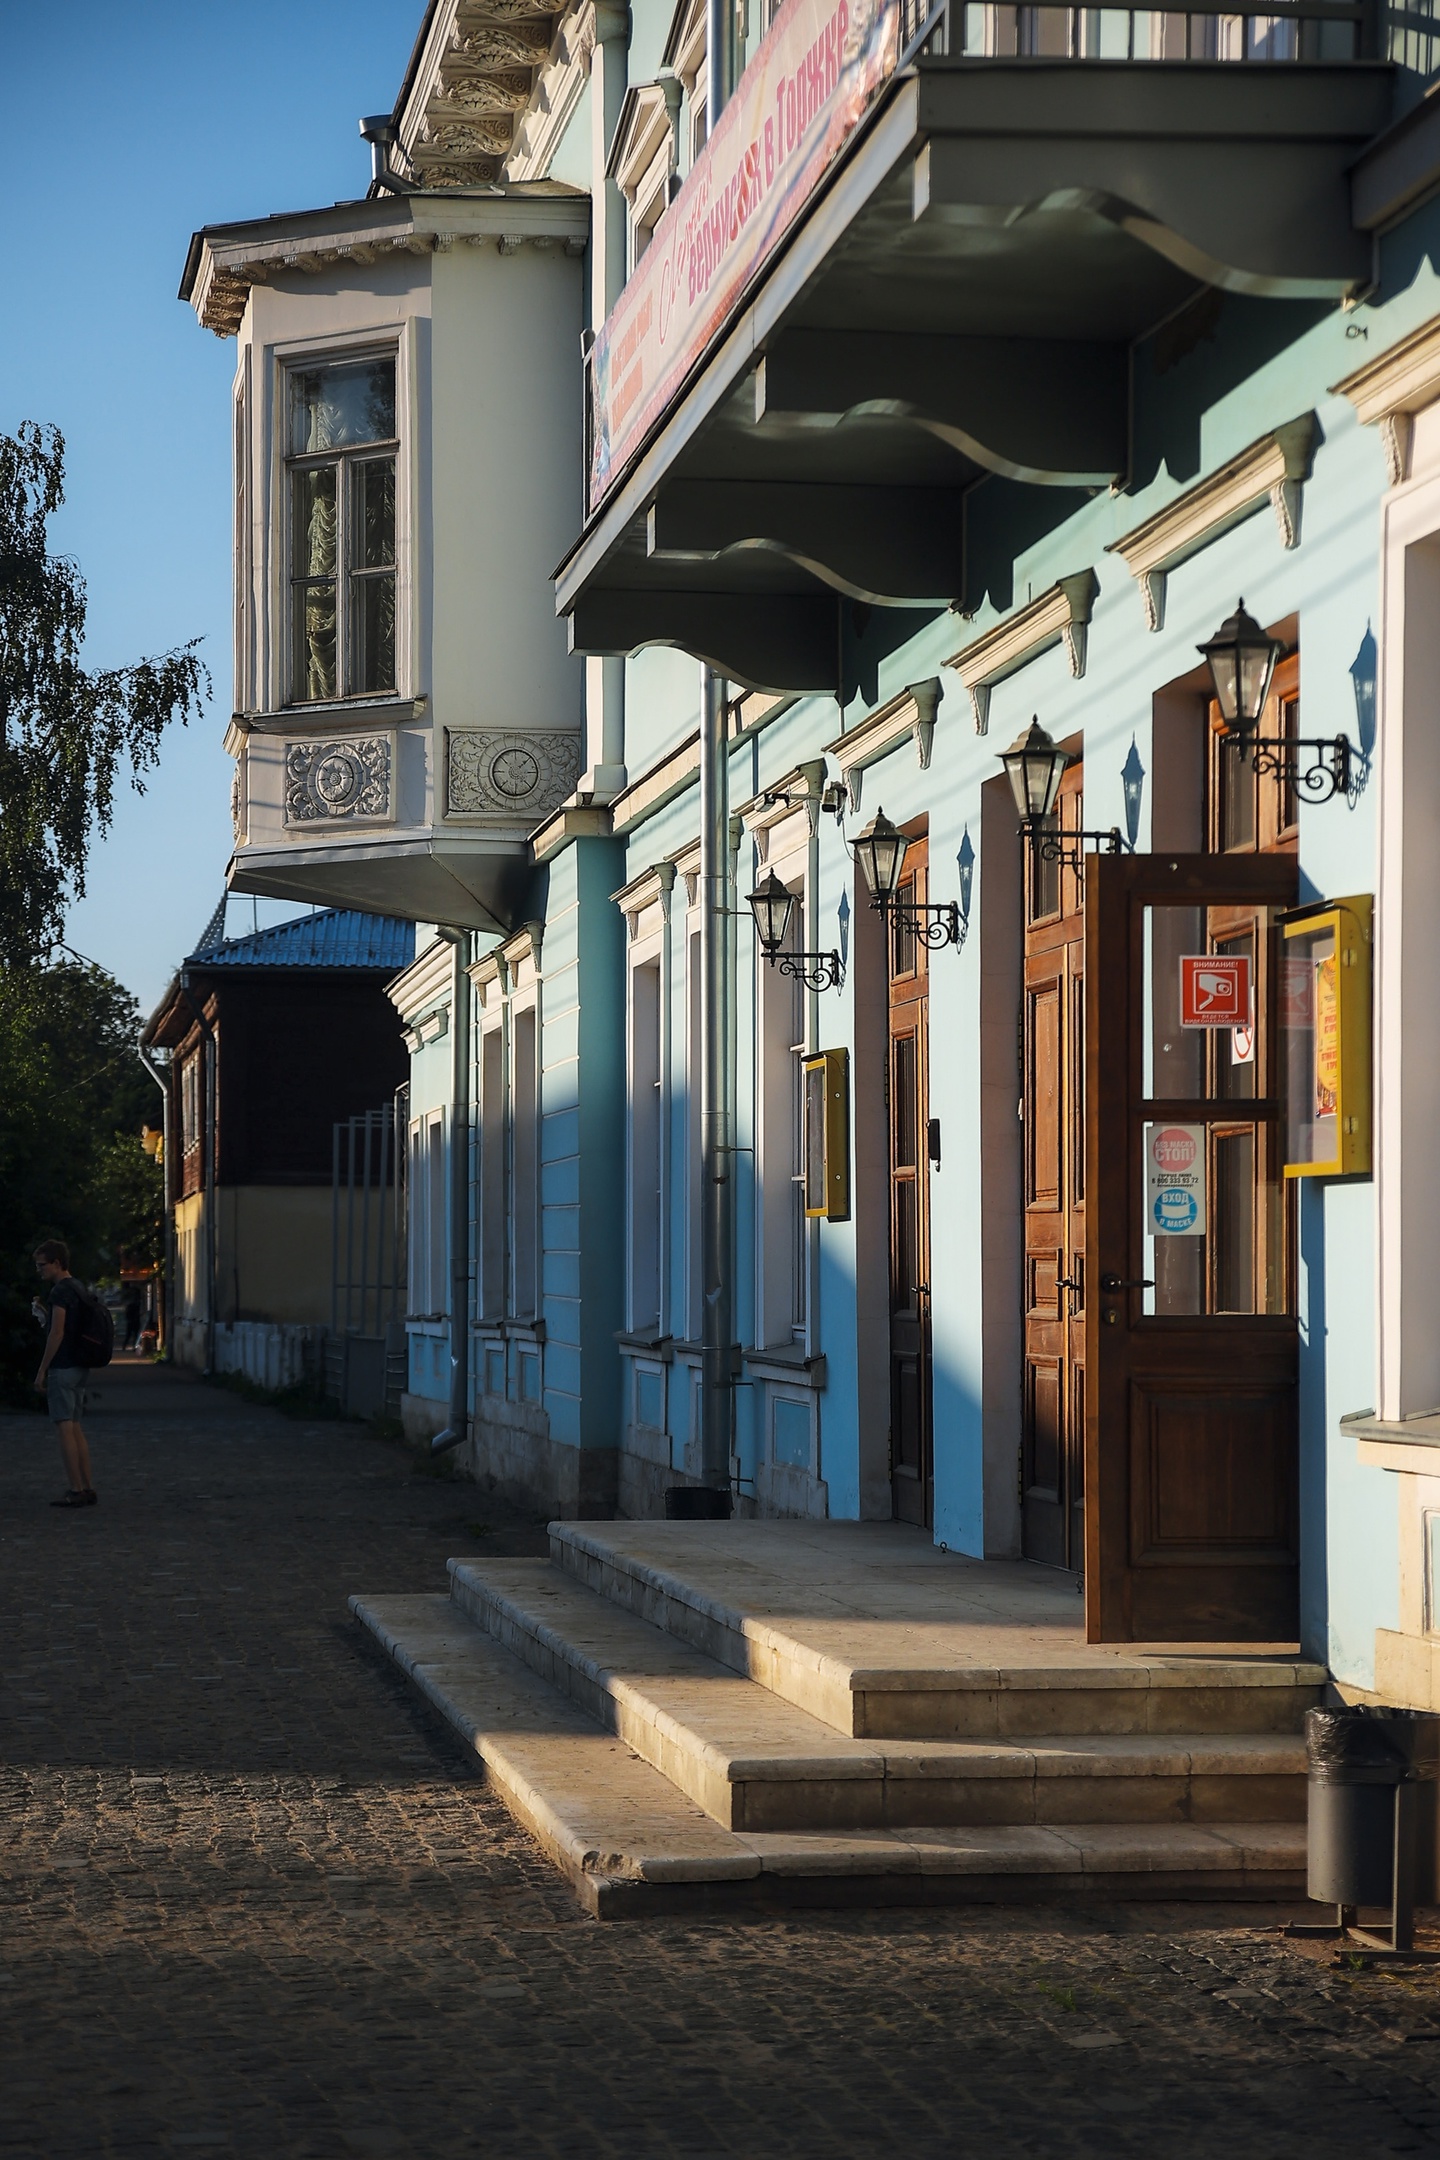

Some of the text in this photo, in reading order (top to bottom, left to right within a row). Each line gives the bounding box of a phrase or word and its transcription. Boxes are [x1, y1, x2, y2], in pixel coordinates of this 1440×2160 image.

[688, 0, 849, 308] вернисаж в Торжке
[1193, 961, 1239, 969] ВНИМАНИЕ!
[1155, 1148, 1195, 1161] СТОП!
[1162, 1193, 1189, 1204] ВХОД
[1167, 1218, 1192, 1228] МАСКЕ
